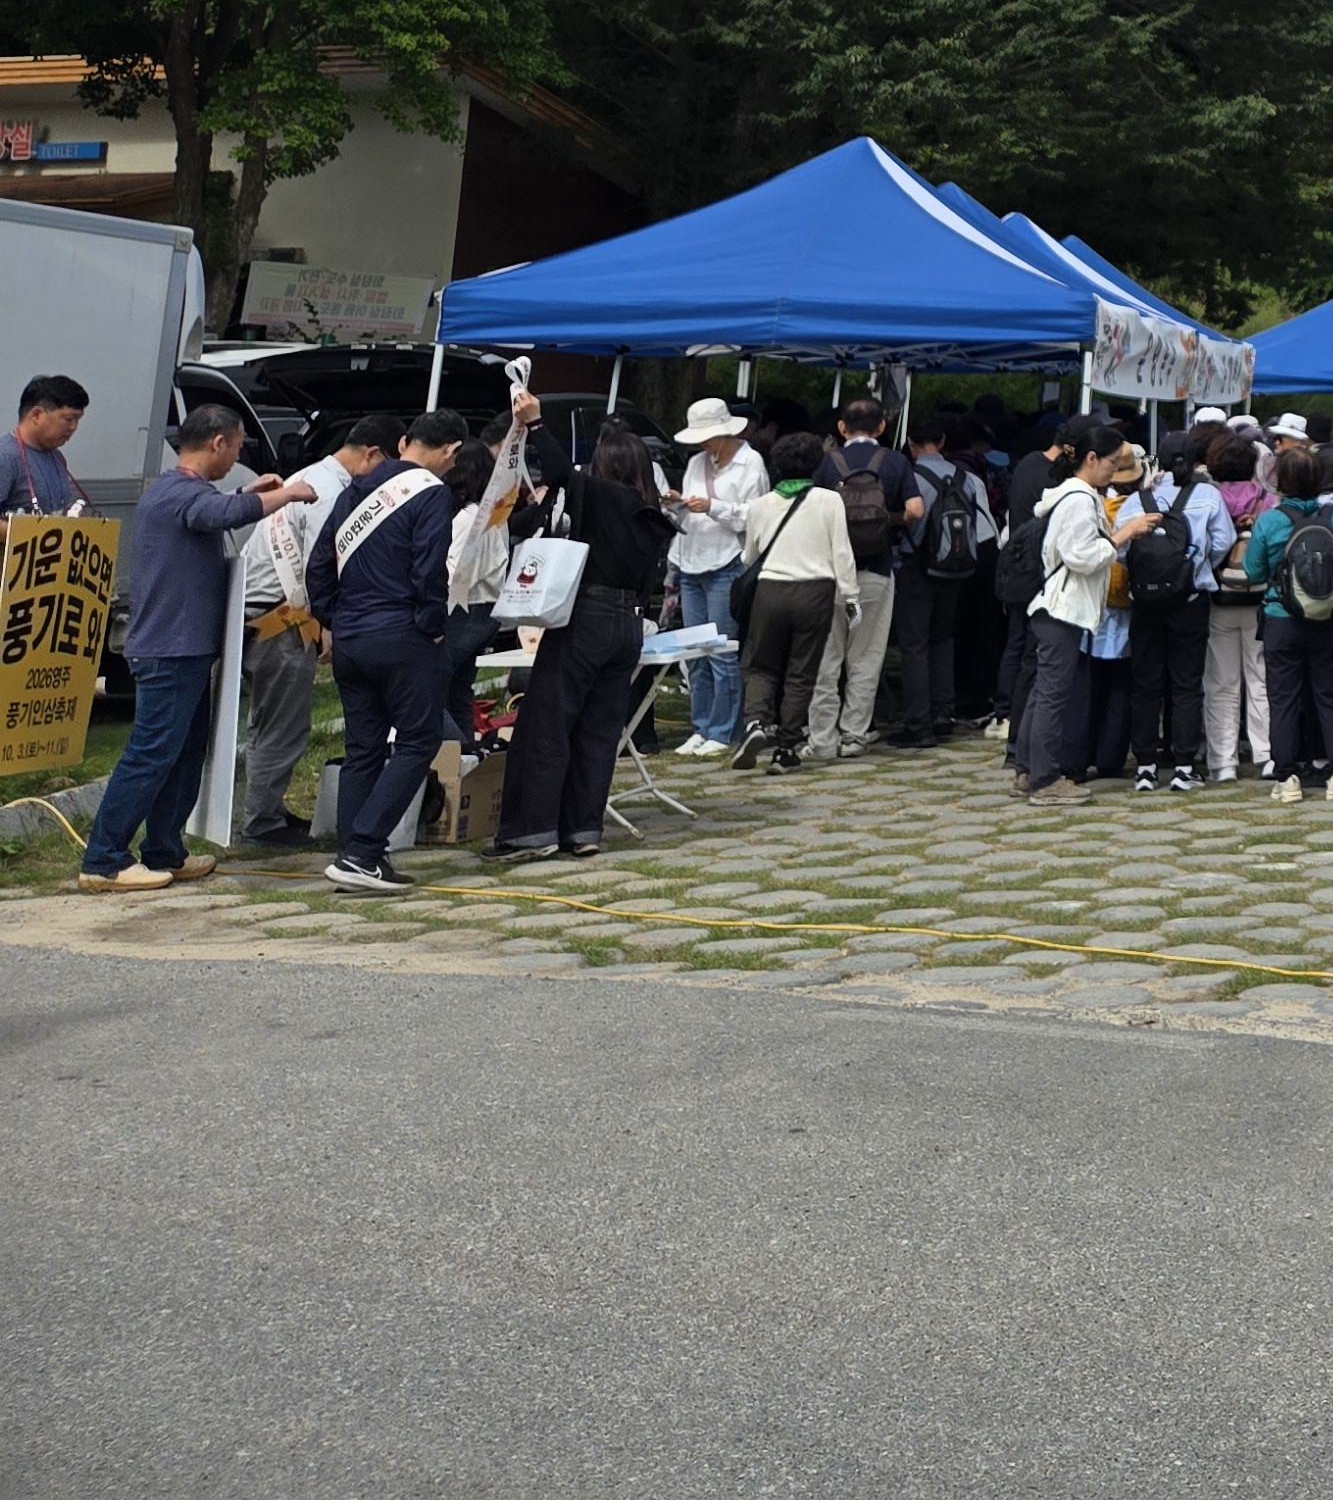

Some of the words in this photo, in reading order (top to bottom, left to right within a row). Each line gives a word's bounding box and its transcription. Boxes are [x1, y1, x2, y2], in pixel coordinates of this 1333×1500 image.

[8, 528, 63, 591] 기운
[67, 529, 114, 605] 없으면
[2, 593, 84, 666] 풍기로
[83, 606, 103, 665] 와
[25, 666, 71, 690] 2026영주
[6, 695, 78, 730] 풍기인삼축제
